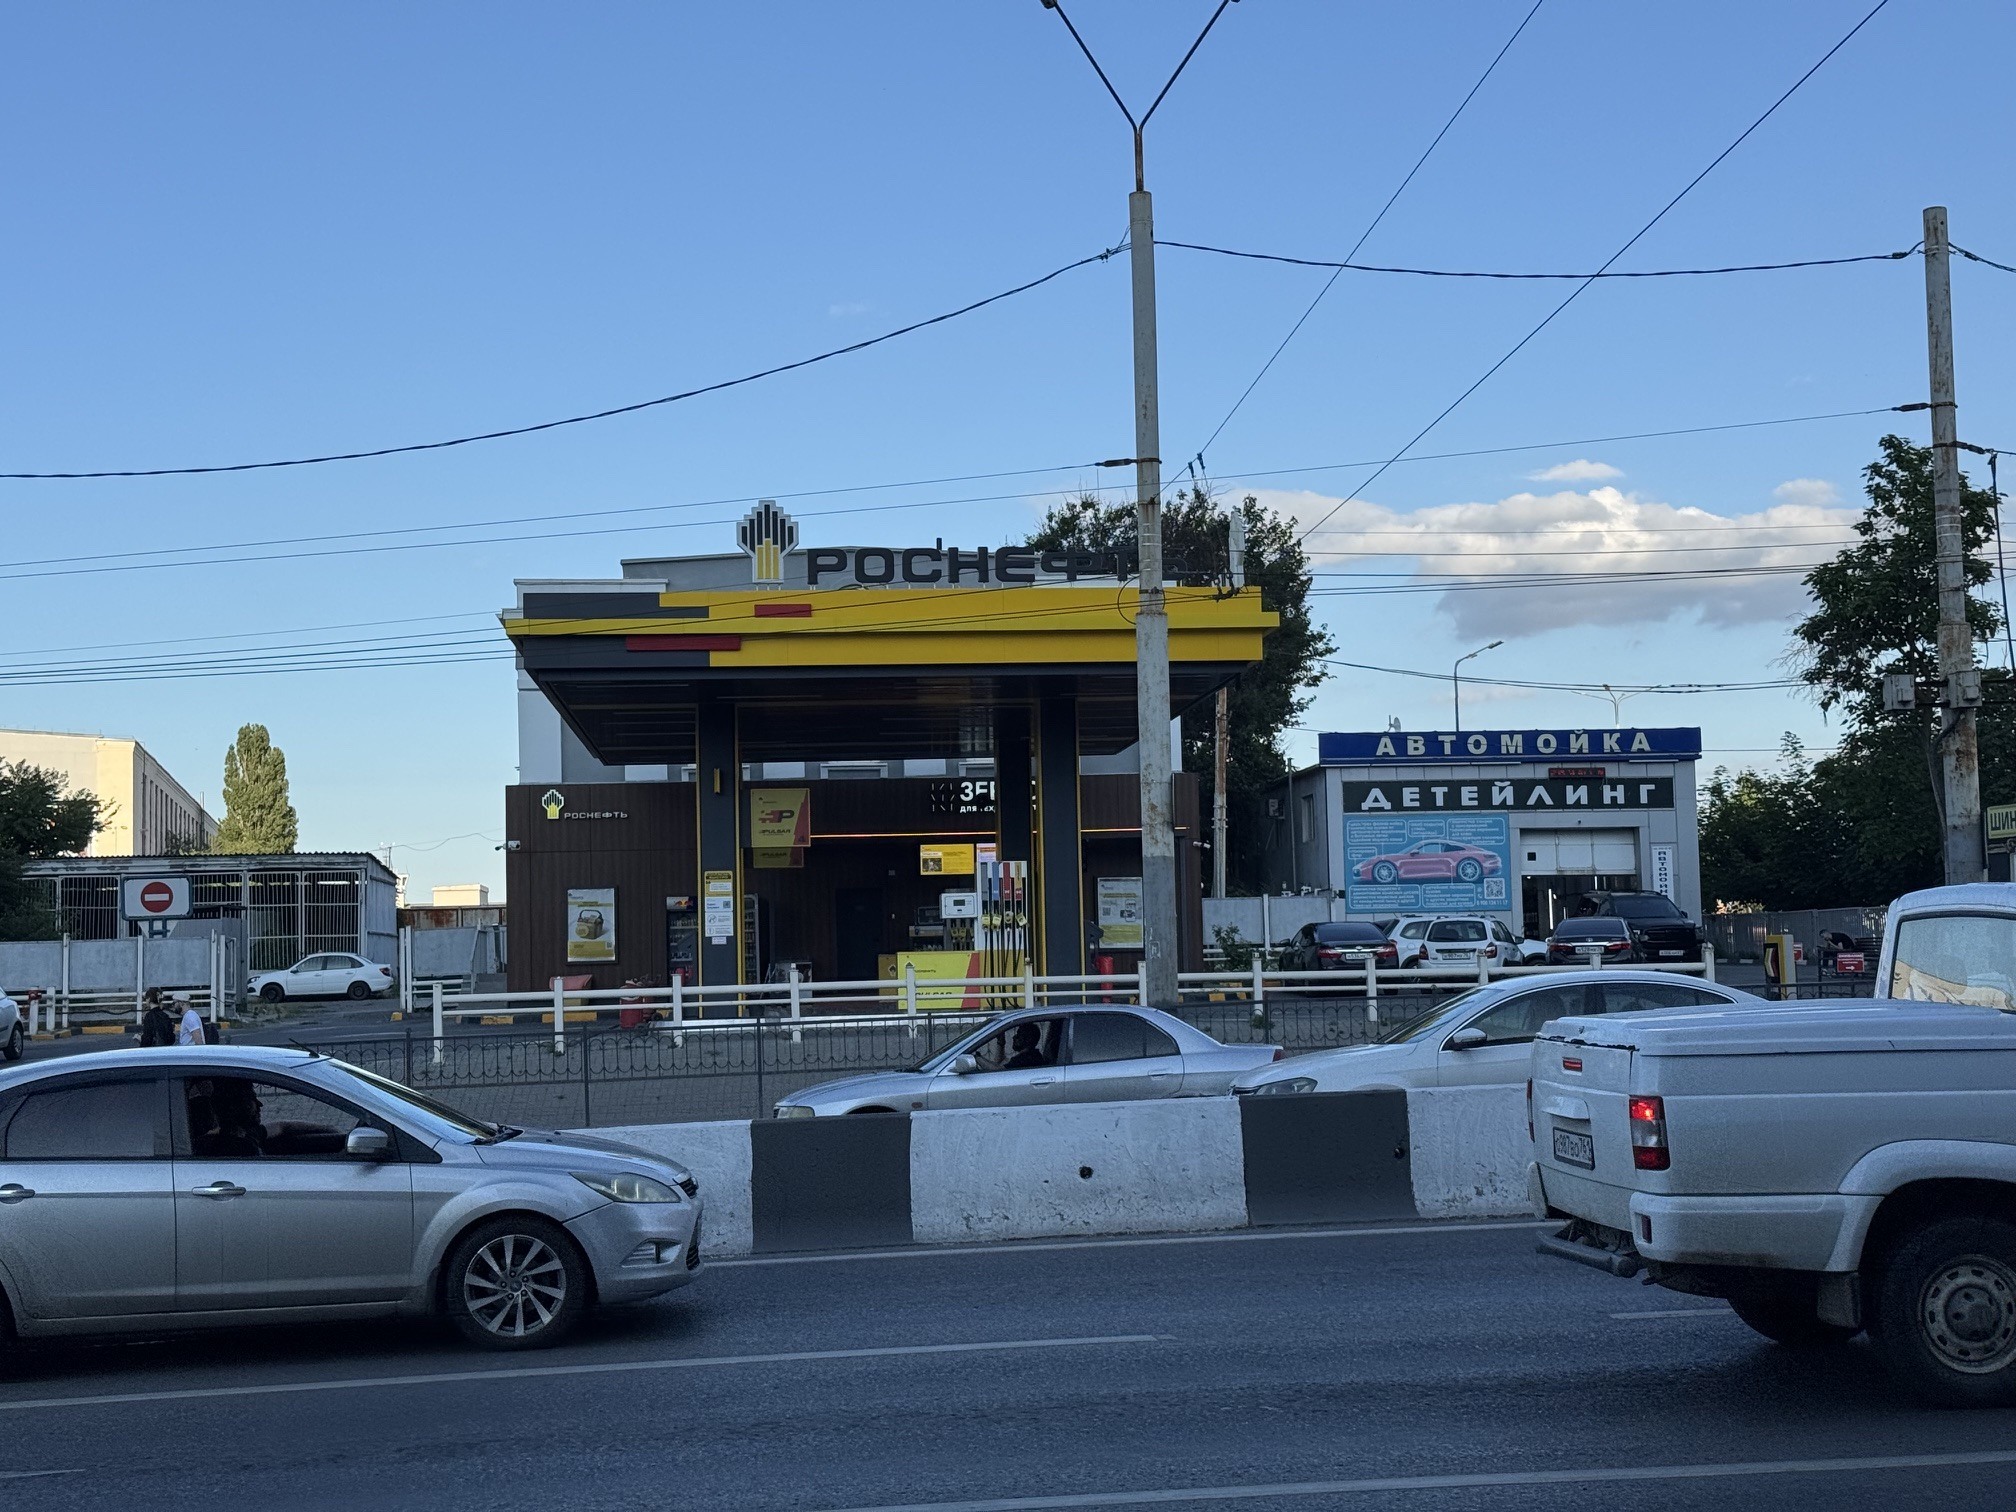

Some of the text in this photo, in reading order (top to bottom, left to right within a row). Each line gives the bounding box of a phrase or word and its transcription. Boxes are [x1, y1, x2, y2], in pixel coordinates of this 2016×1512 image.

[1376, 730, 1652, 757] АВТОМОЙКА
[1360, 780, 1656, 811] ДЕТЕЙЛИНГ
[563, 811, 629, 820] РОСНЕФТЬ
